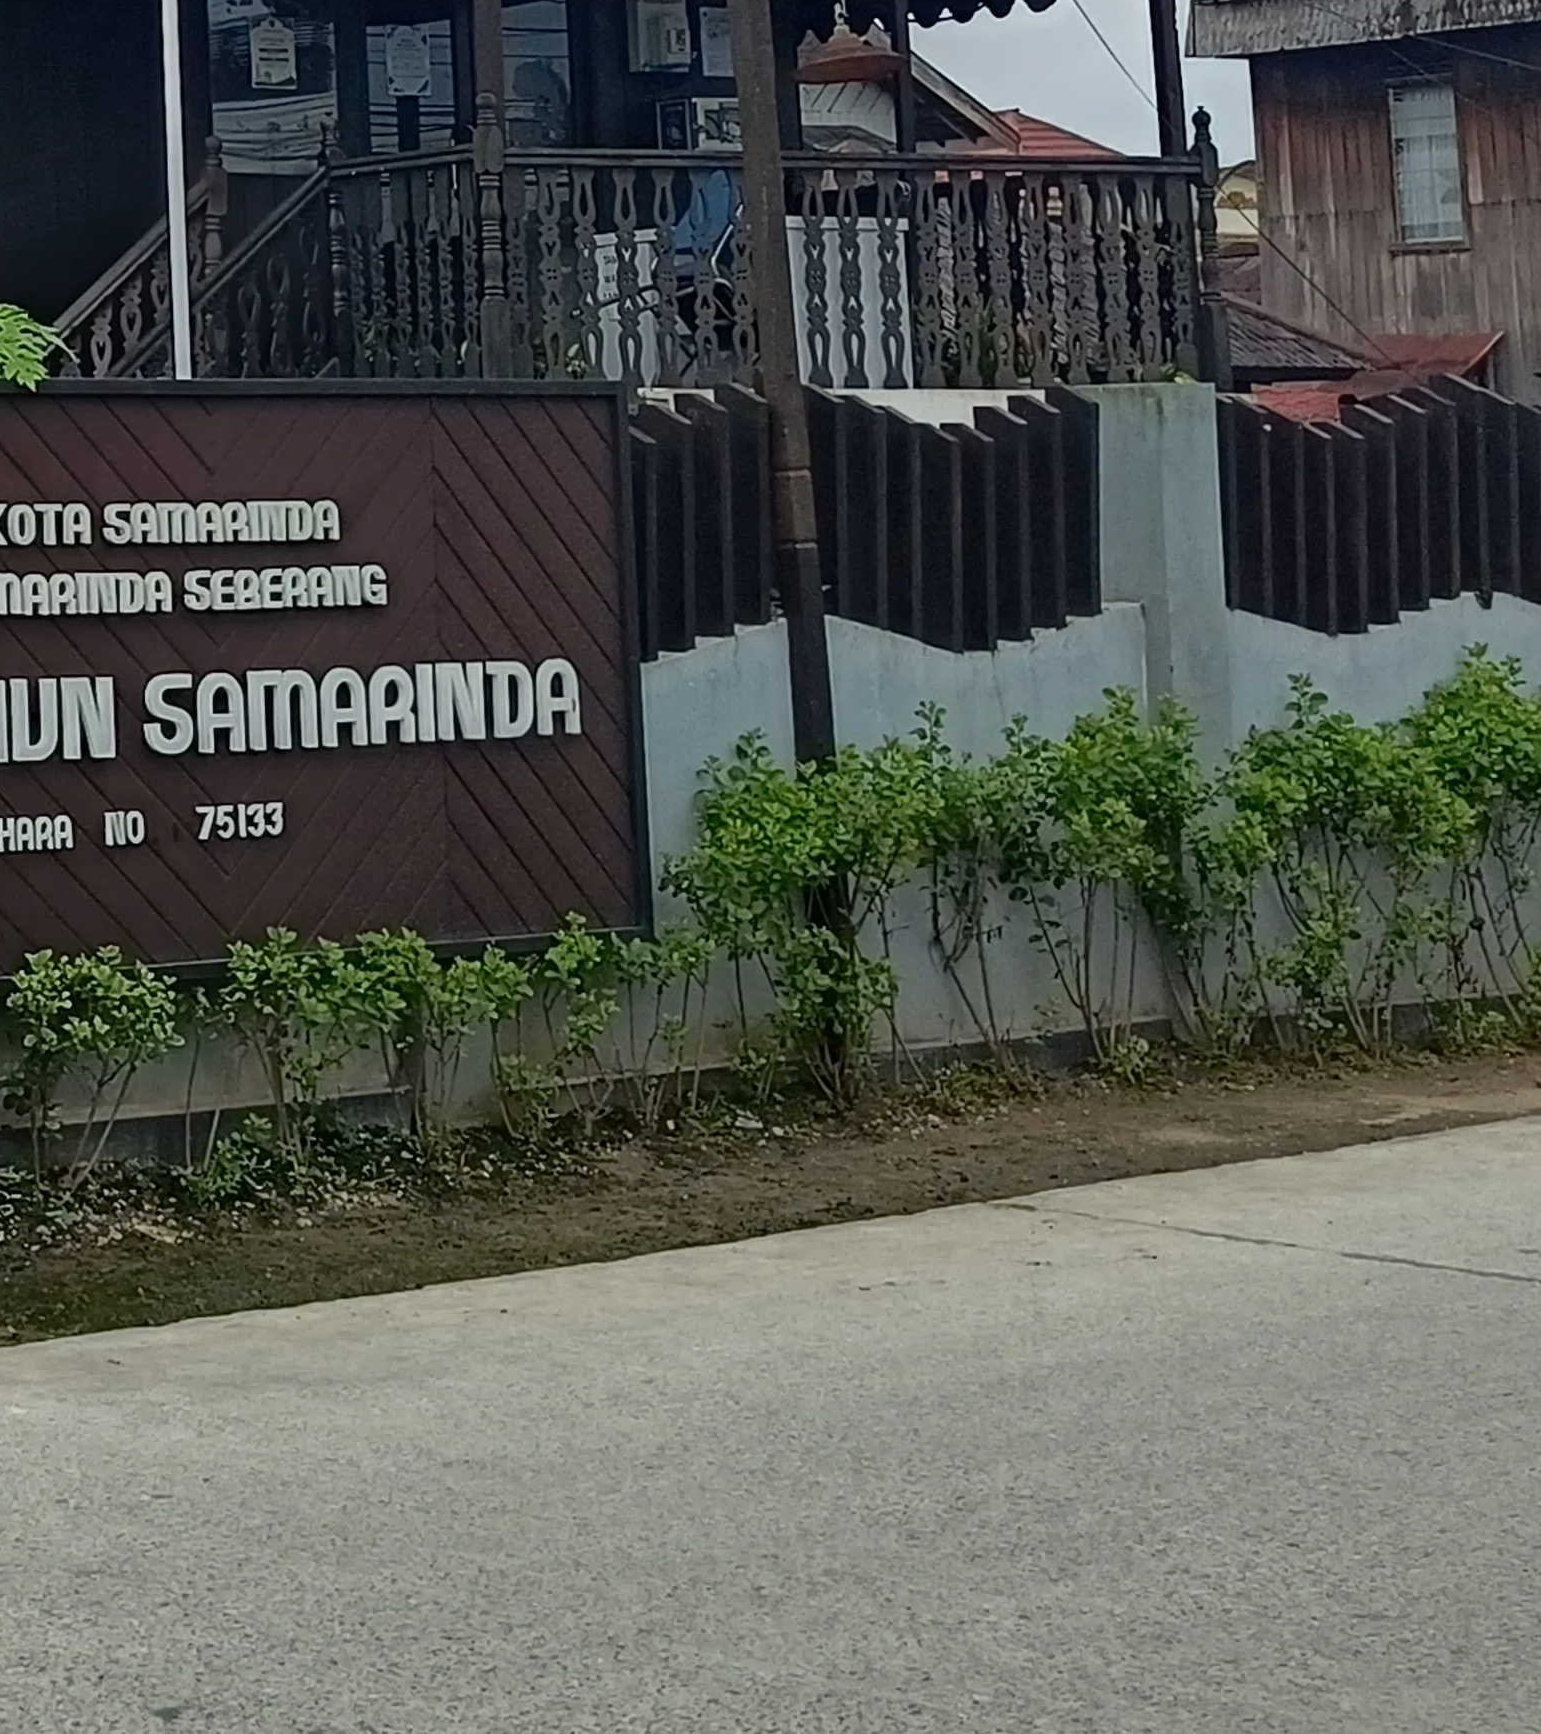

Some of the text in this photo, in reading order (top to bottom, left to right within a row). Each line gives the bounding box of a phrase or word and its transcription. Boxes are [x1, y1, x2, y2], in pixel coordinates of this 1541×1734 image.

[103, 499, 341, 545] SAMARINDA
[183, 564, 388, 612] SEBERANG
[143, 657, 583, 756] SAMARINDA
[104, 810, 146, 846] NO
[195, 801, 285, 842] 75133
